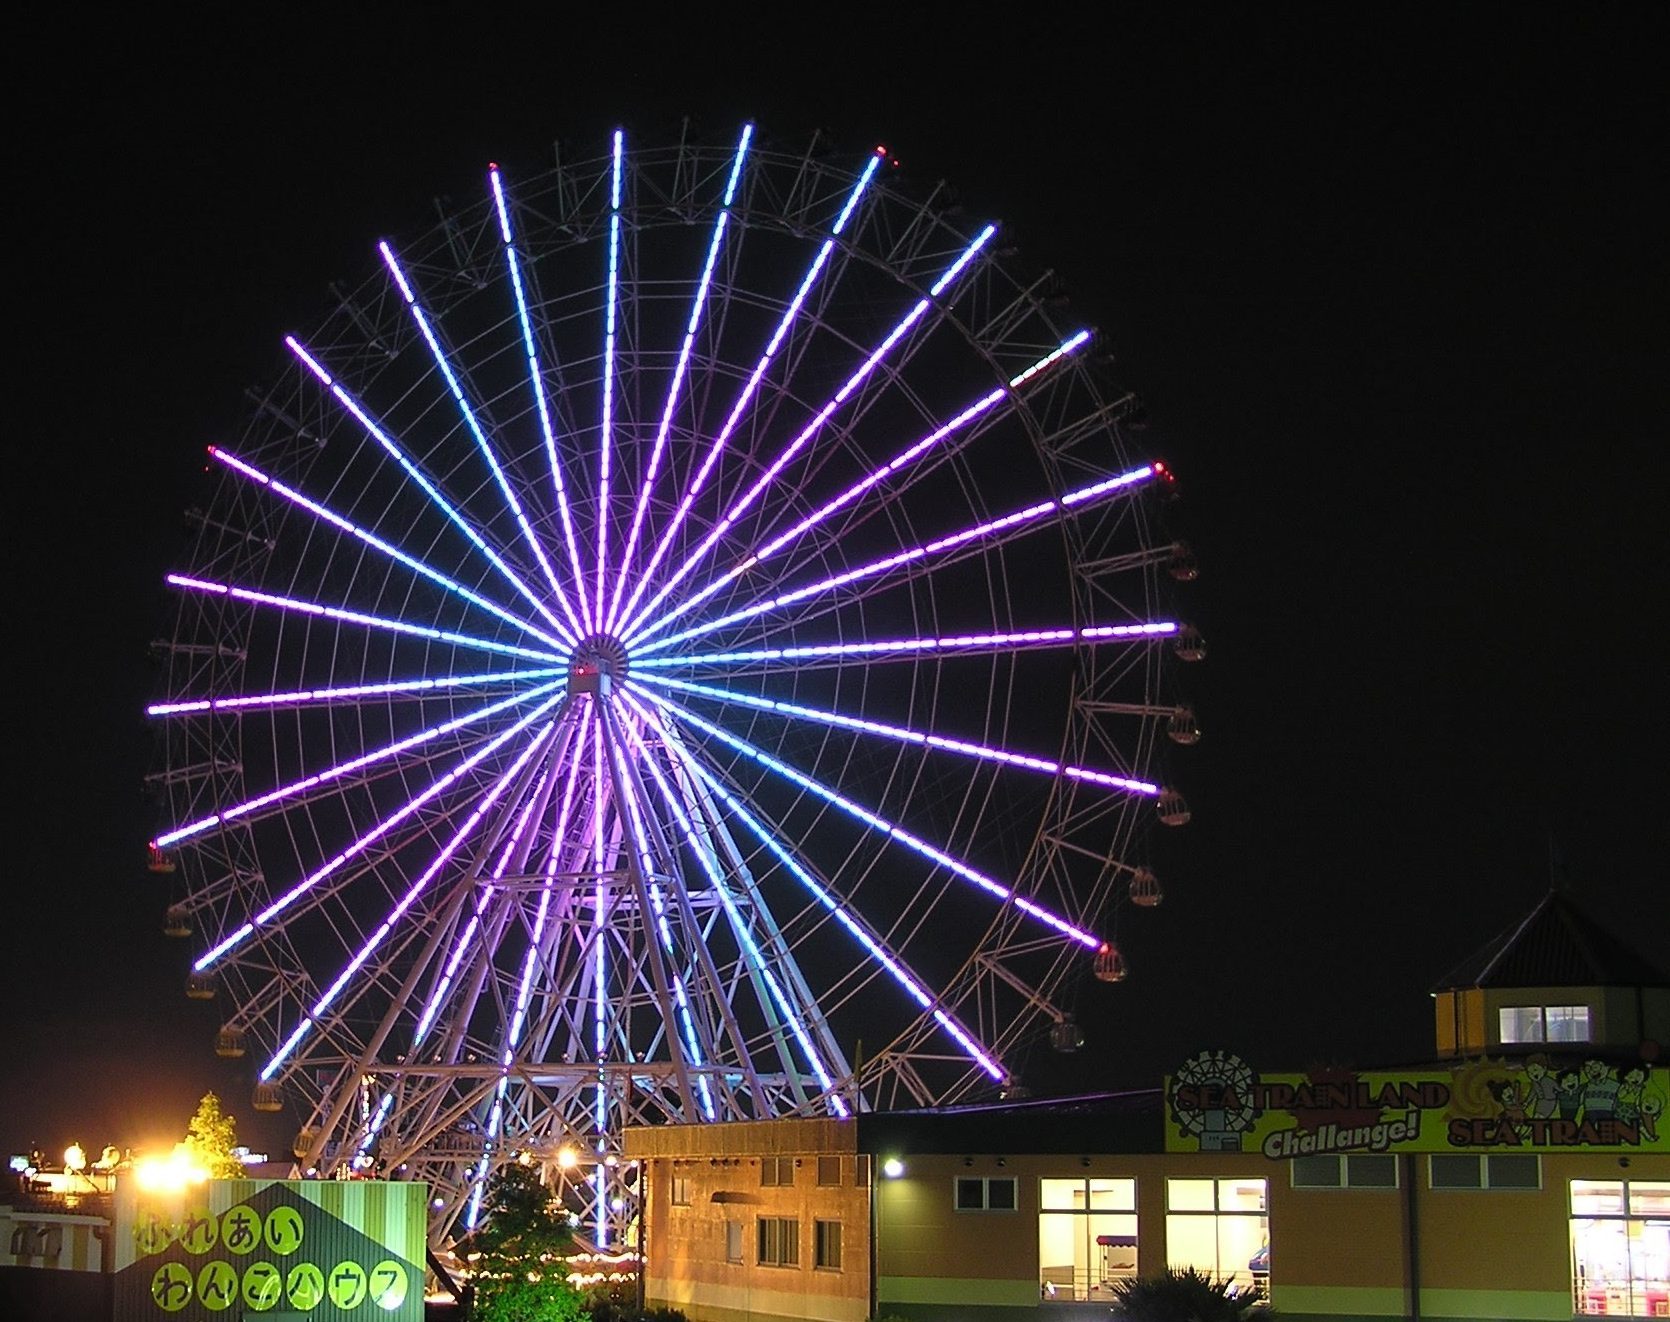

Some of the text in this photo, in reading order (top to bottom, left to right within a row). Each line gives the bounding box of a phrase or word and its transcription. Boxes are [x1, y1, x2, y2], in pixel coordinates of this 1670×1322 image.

[1177, 1080, 1450, 1111] SEA TRAIN LAND
[1263, 1109, 1420, 1160] Challange!
[1448, 1118, 1640, 1146] SEA TRAIN
[134, 1210, 302, 1251] ふれあい
